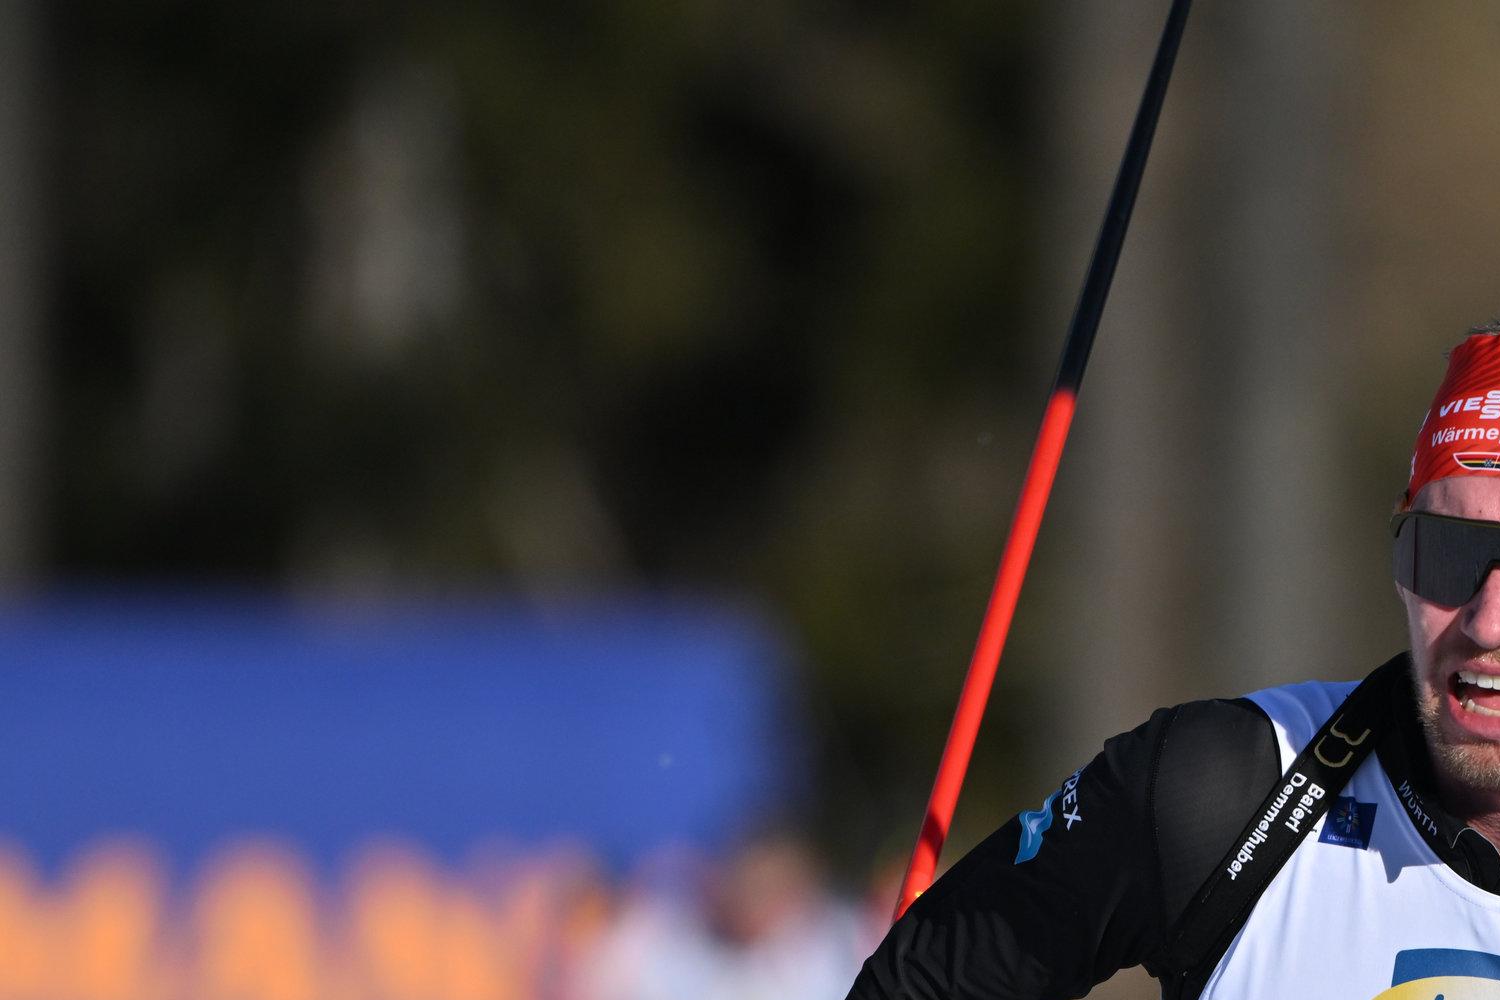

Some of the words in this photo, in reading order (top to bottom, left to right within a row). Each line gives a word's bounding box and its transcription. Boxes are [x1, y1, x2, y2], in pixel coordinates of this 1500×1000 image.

[1226, 772, 1307, 880] Demmelhuber
[1284, 783, 1325, 833] Baierl
[1399, 780, 1437, 836] WÜRTH
